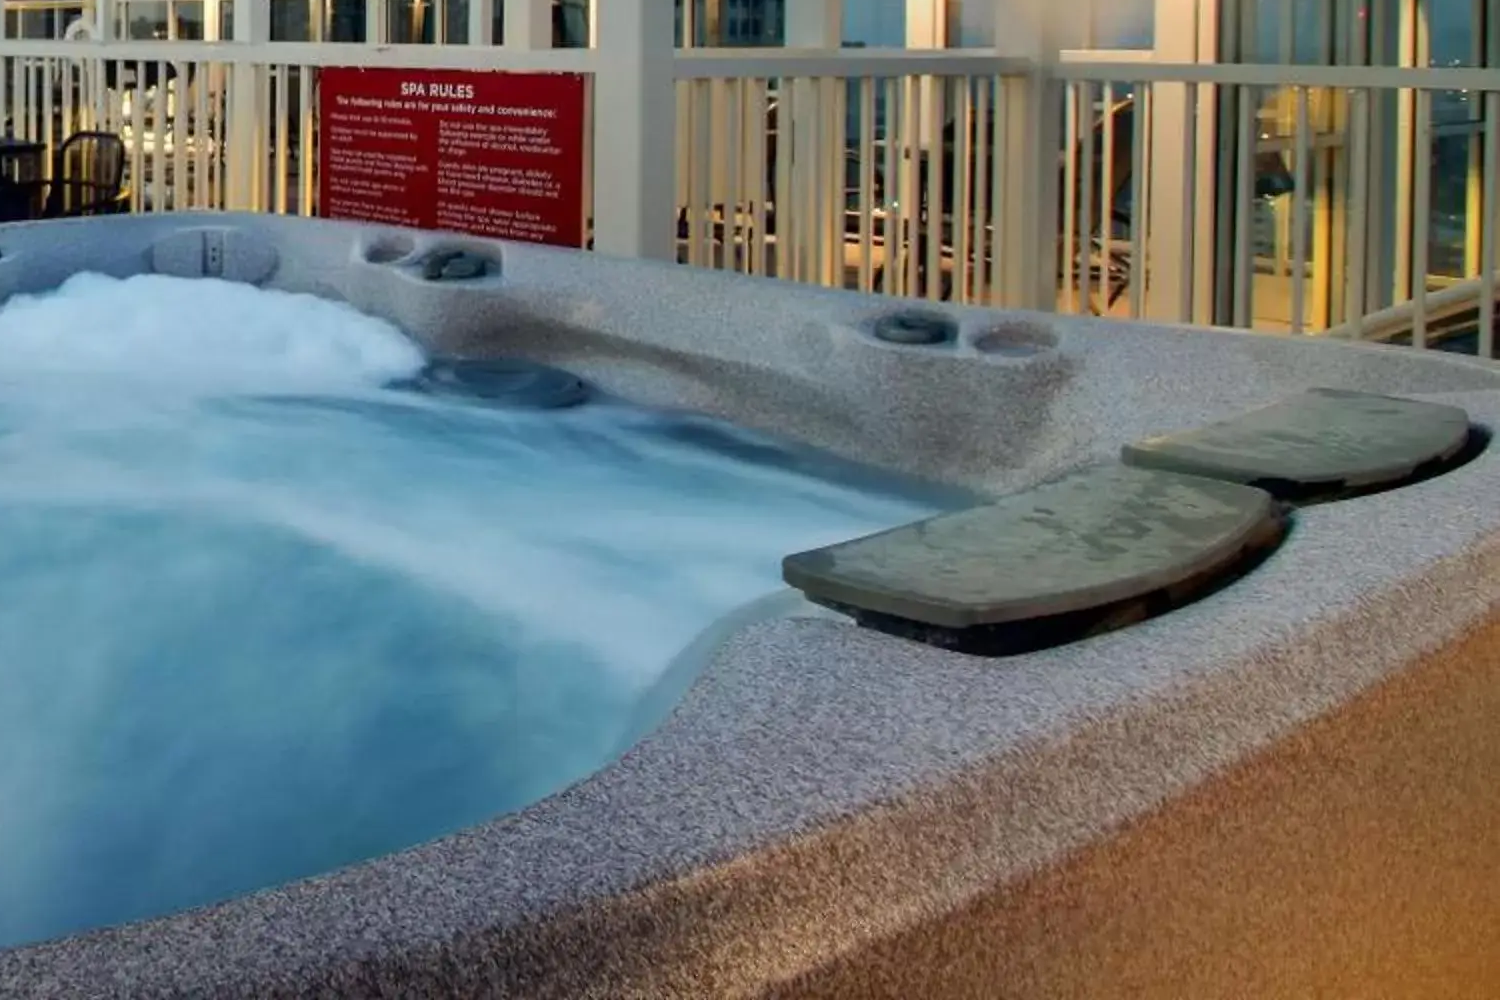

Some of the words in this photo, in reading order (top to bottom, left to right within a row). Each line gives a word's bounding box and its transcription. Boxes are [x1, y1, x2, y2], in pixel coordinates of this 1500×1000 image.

[401, 82, 425, 96] SPA
[430, 83, 474, 98] RULES
[418, 101, 430, 111] for
[432, 103, 448, 113] your
[478, 104, 495, 115] and
